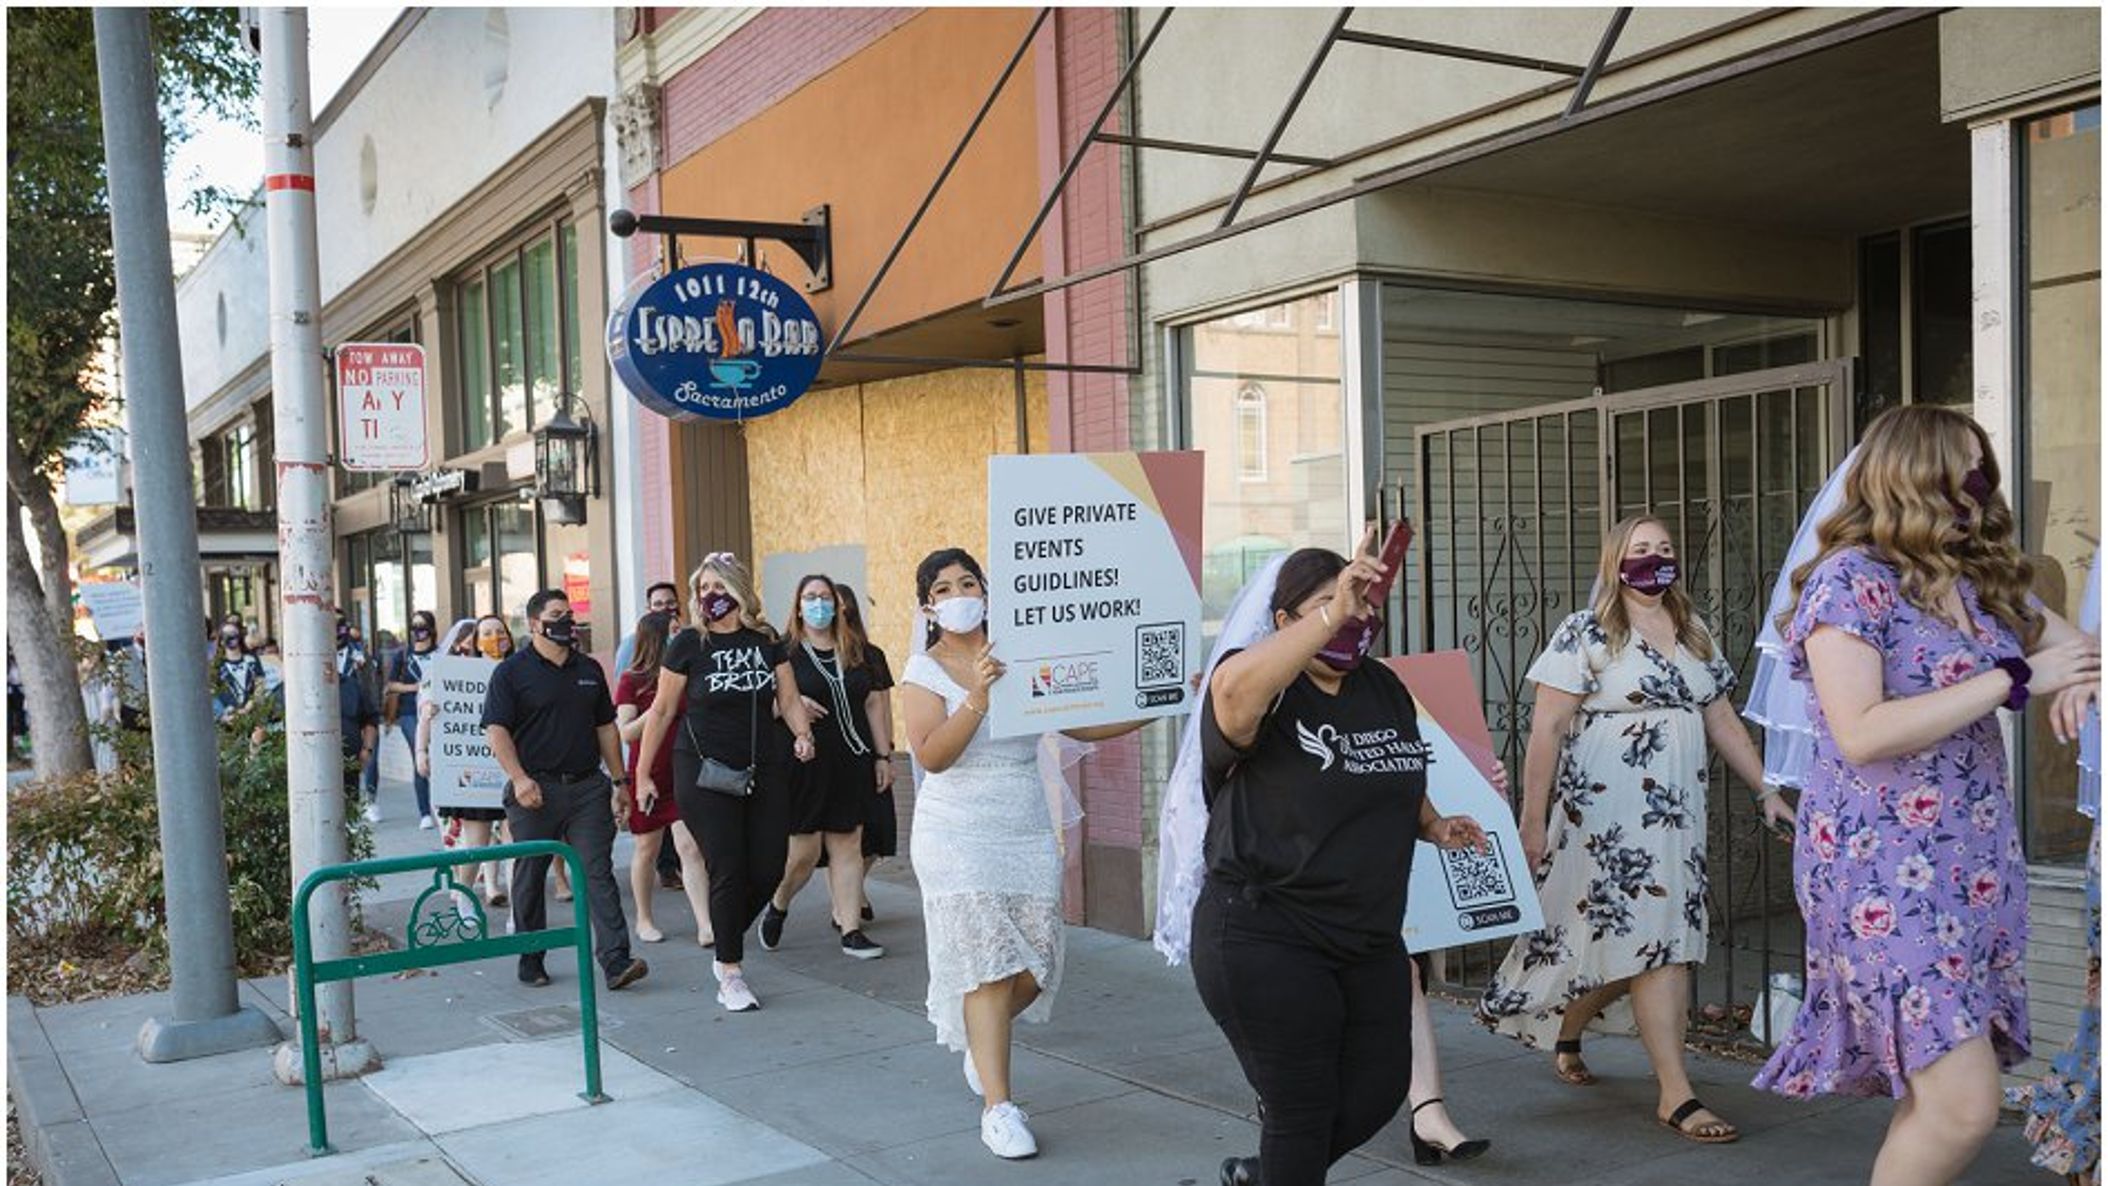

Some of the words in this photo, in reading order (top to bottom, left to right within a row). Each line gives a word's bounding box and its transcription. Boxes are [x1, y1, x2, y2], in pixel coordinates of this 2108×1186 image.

[674, 274, 725, 302] 1011
[737, 276, 780, 309] 12th
[349, 351, 374, 365] TOW
[382, 351, 413, 365] AWAY
[346, 369, 370, 385] NO
[376, 371, 418, 386] PARKING
[363, 390, 404, 411] AY
[674, 381, 787, 409] Sacramento
[1014, 507, 1056, 527] GIVE
[1063, 503, 1137, 525] PRIVATE
[1014, 538, 1083, 560] EVENTS
[1014, 568, 1119, 594] GUIDLINES!
[1014, 606, 1046, 627] LET
[1052, 604, 1076, 623] US
[1080, 598, 1141, 621] WORK!
[711, 646, 770, 672] TEAM
[1053, 661, 1098, 685] CAPE
[443, 679, 487, 694] WEDD
[443, 701, 474, 714] CAN
[443, 722, 487, 736] SAFEL
[1352, 728, 1398, 746] DIEGO
[443, 743, 463, 756] US
[465, 744, 496, 758] WO
